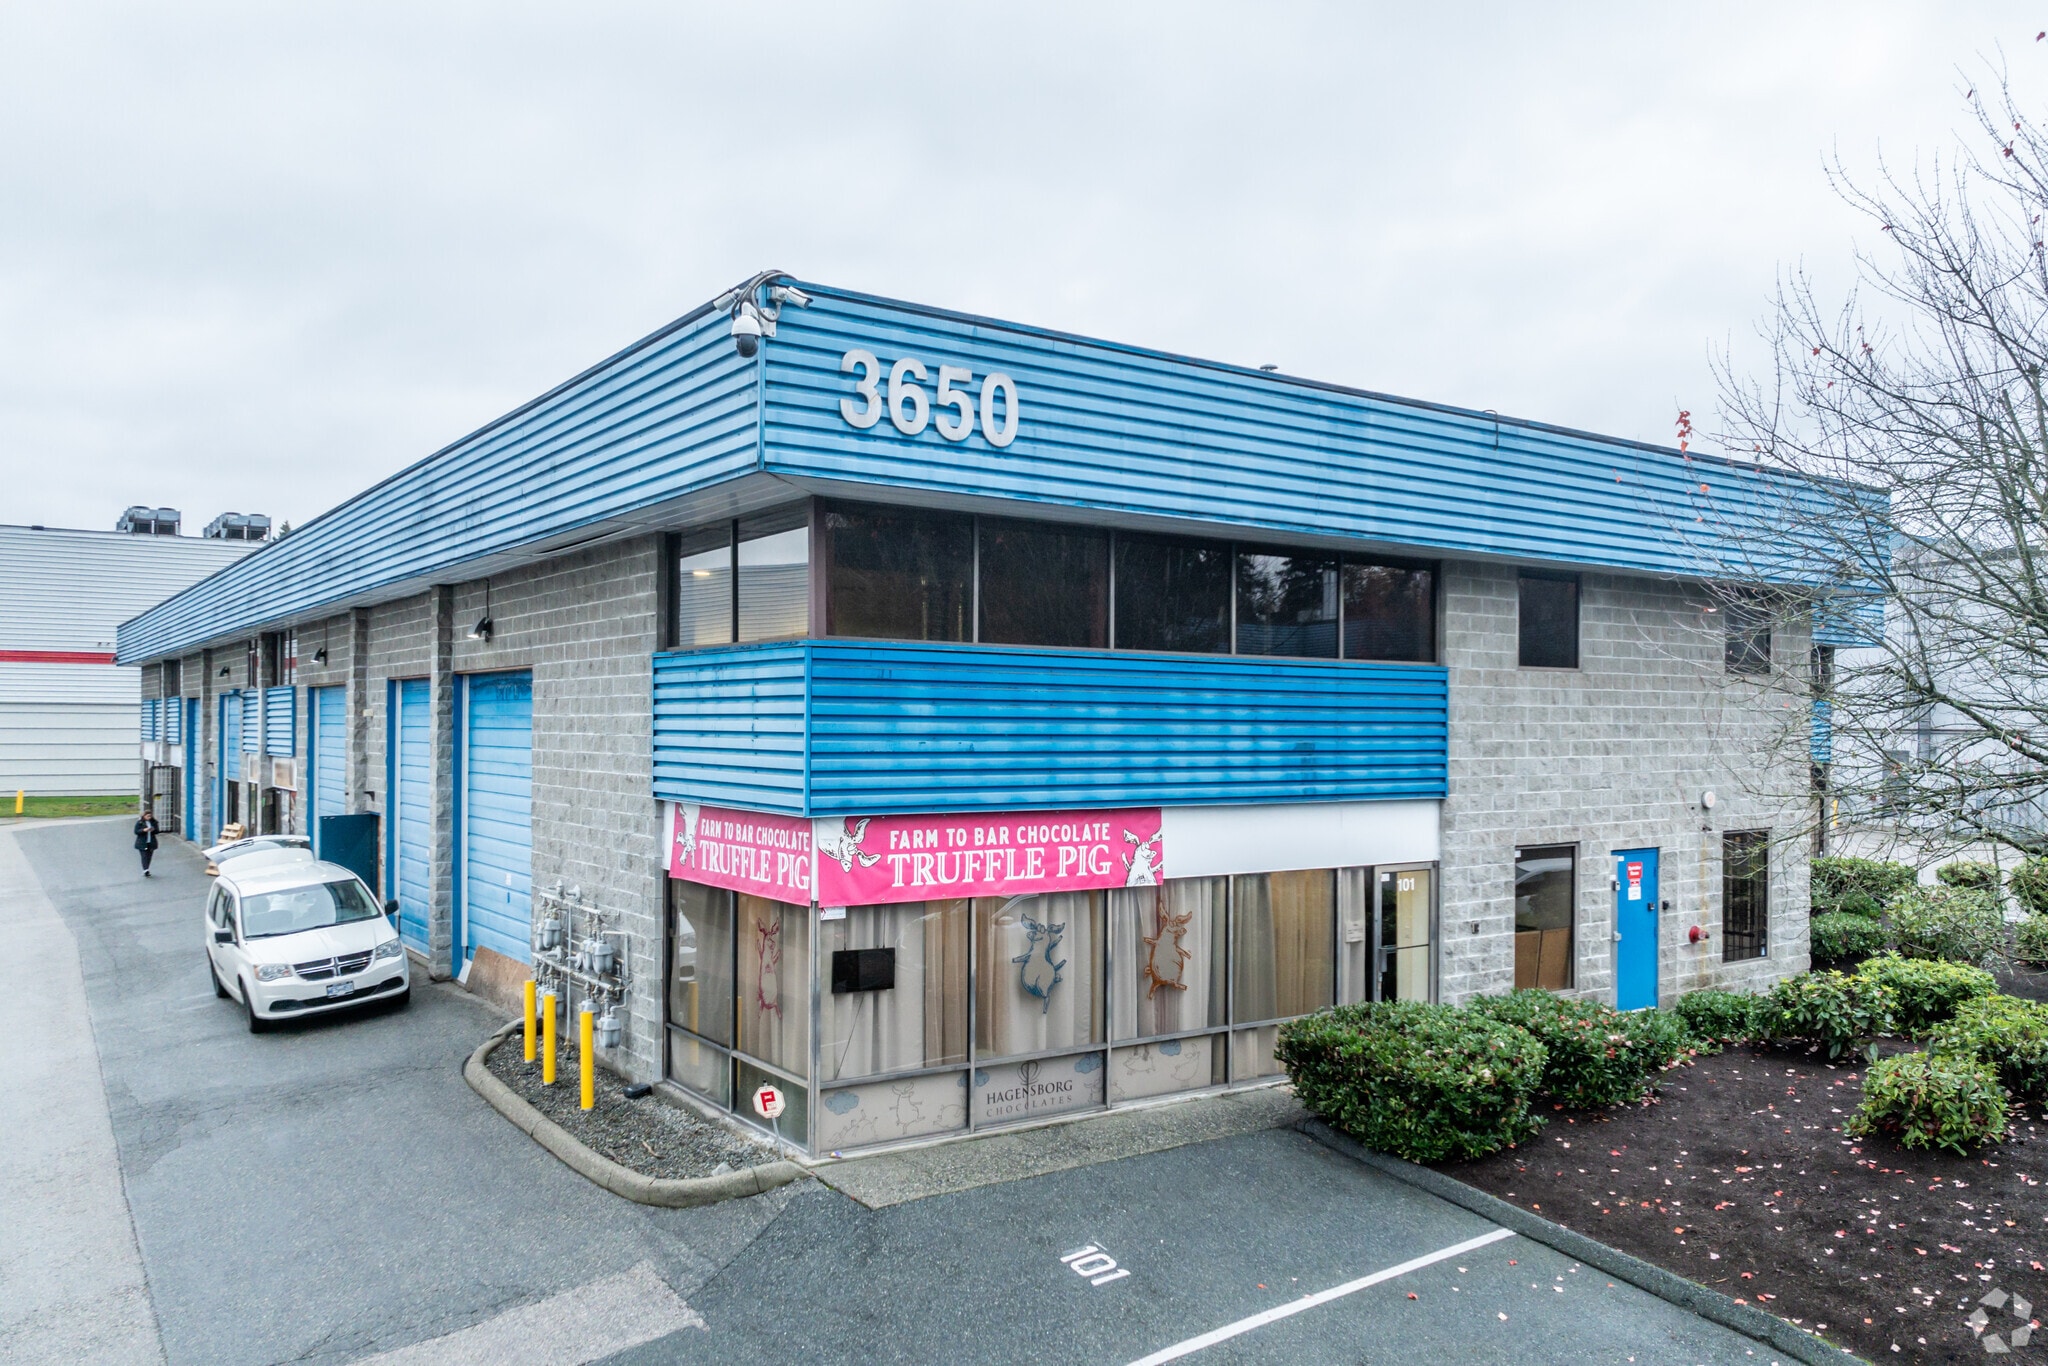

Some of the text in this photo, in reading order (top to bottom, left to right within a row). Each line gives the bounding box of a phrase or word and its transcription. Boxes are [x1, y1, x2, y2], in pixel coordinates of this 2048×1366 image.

[840, 349, 1019, 448] 3650
[700, 818, 810, 852] FARM TO BAR CHOCOLATE
[890, 822, 1111, 850] FARM TO BAR CHOCOLATE
[699, 839, 810, 890] TRUFFLE PIG
[887, 844, 1113, 888] TRUFFLE PIG
[1397, 877, 1415, 892] 101
[986, 1079, 1073, 1105] HAGENSBORG
[986, 1095, 1073, 1117] CHOCOLATES
[1060, 1245, 1132, 1287] 101
